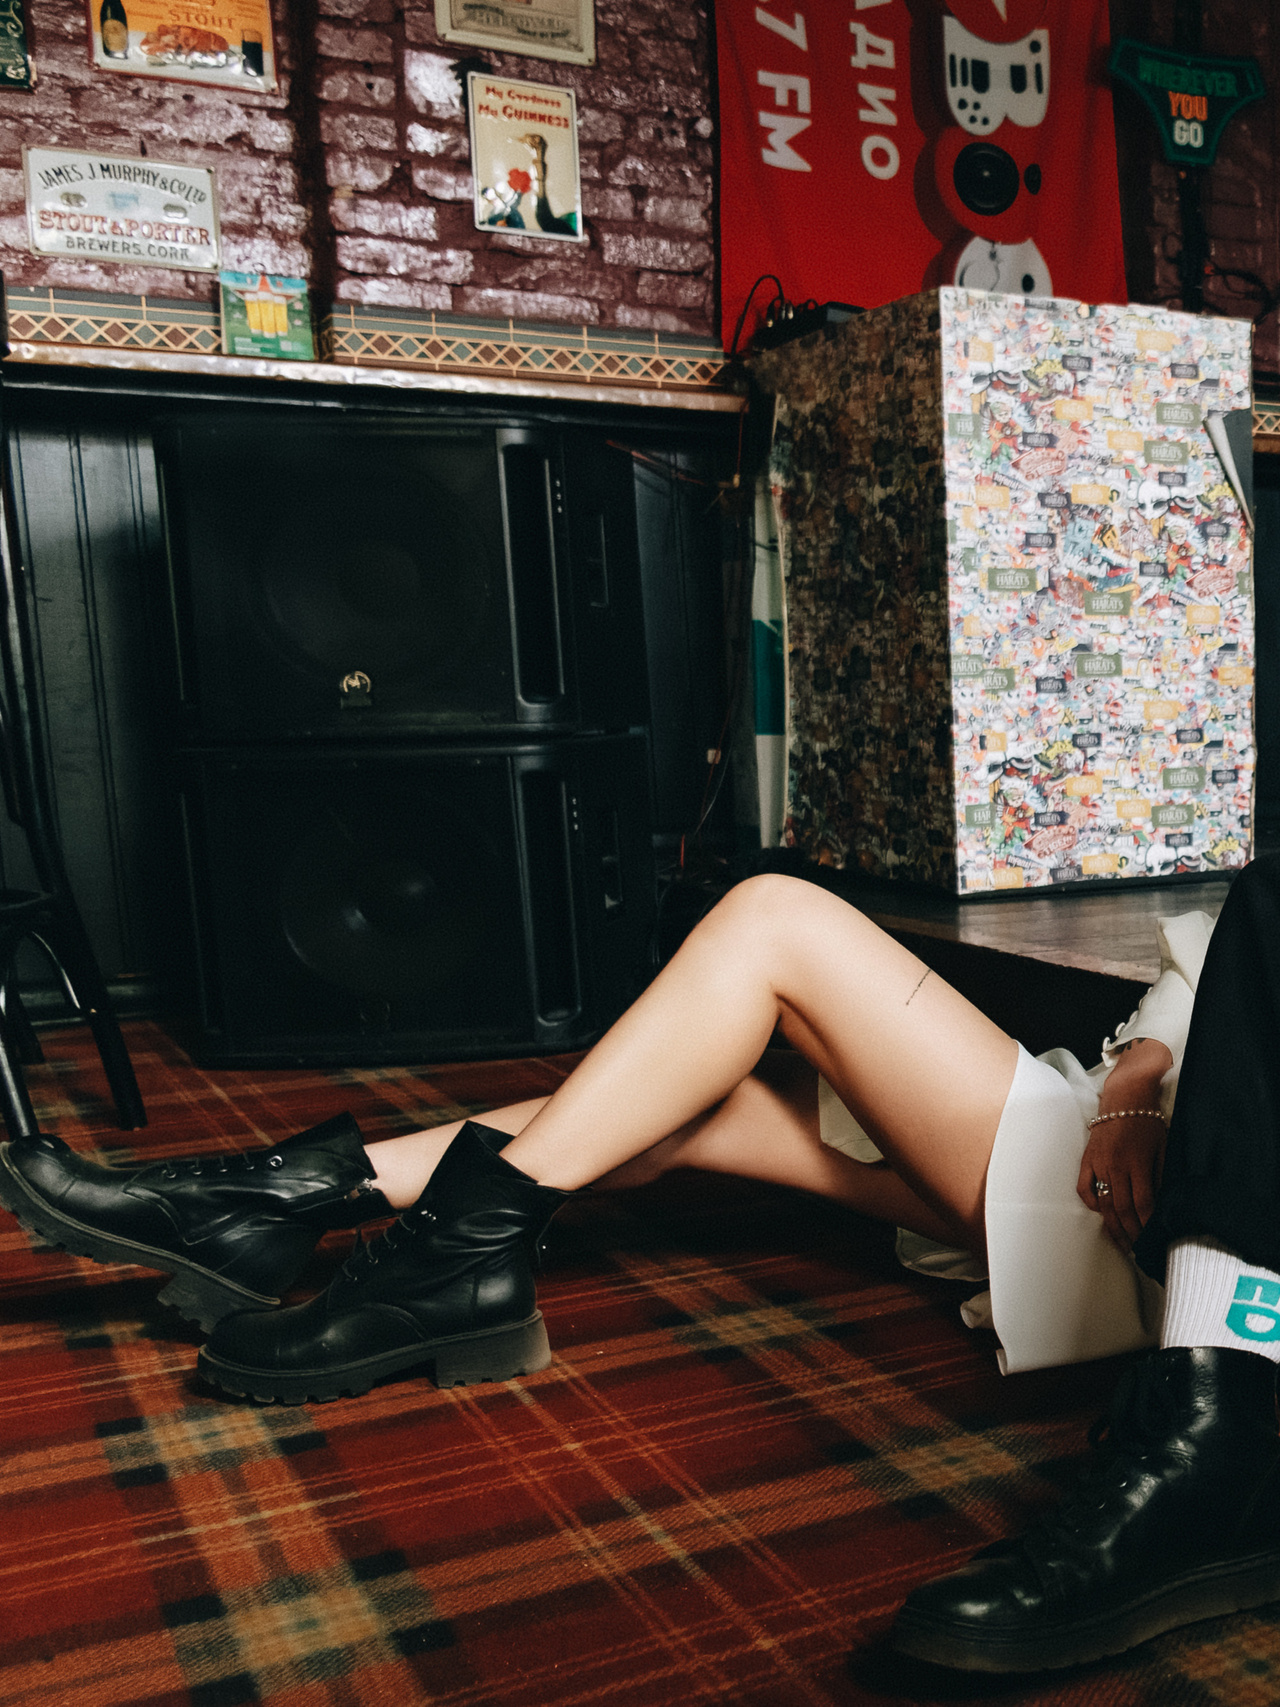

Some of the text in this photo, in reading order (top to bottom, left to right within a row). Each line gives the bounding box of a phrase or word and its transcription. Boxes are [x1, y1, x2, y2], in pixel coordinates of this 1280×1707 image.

[168, 9, 235, 30] STOUT
[755, 0, 812, 173] 7 FM
[850, 0, 900, 180] ДИО
[1138, 56, 1239, 98] WHEREVER
[1168, 90, 1208, 121] YOU
[1173, 119, 1204, 148] GO
[37, 163, 84, 190] JAMES
[99, 163, 160, 187] MURPHY
[38, 209, 108, 235] STOUT
[124, 217, 211, 246] PORTER
